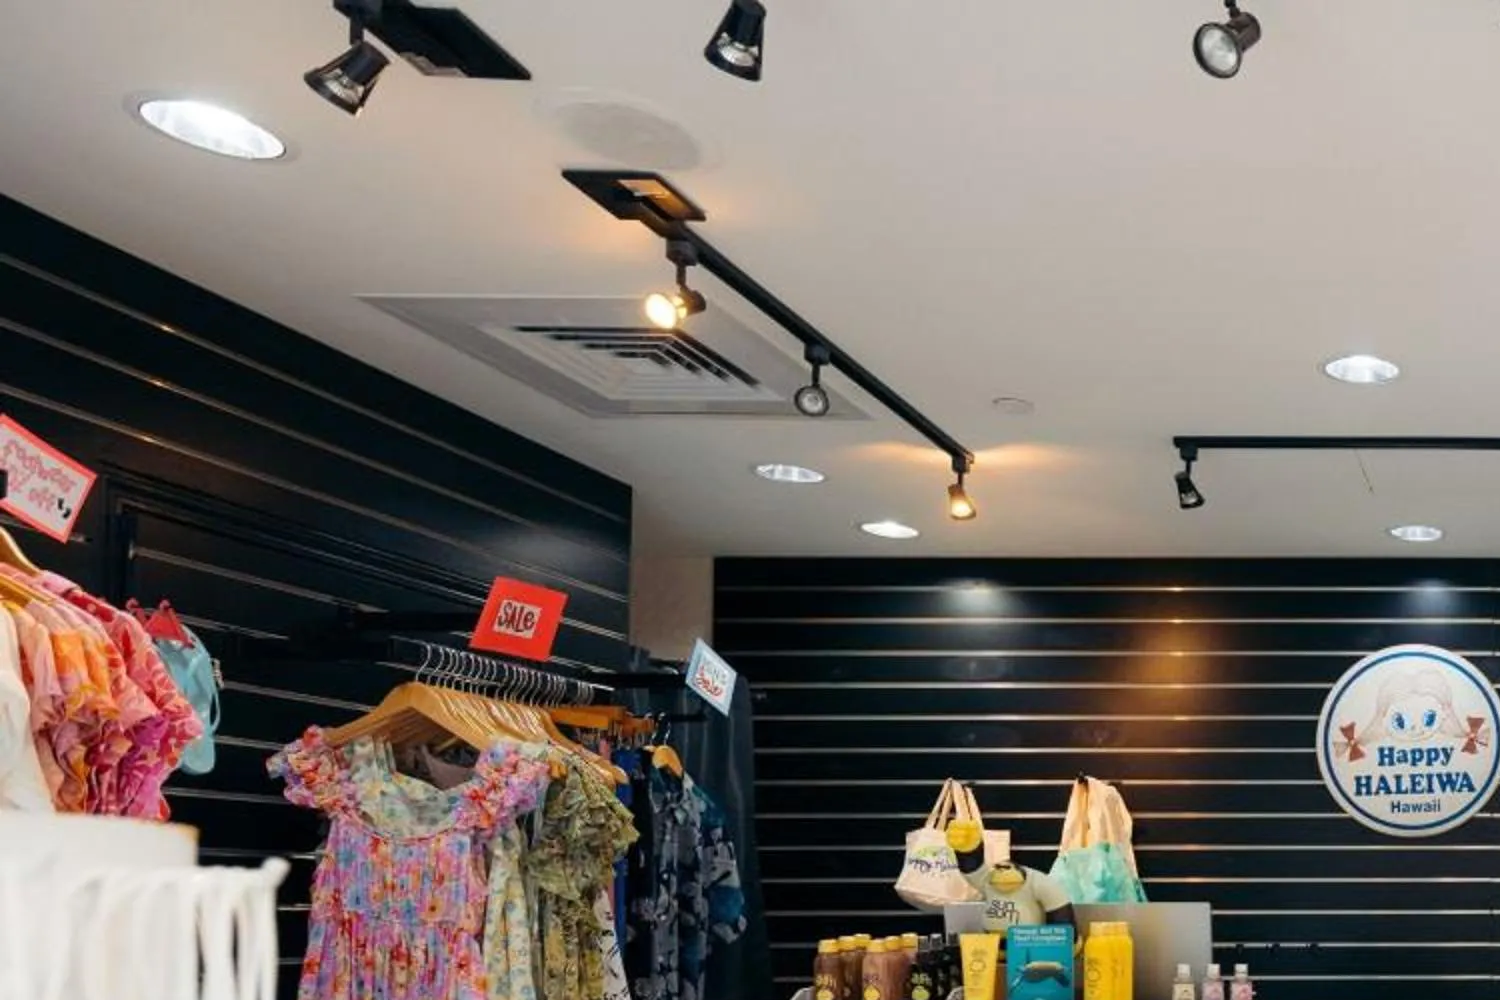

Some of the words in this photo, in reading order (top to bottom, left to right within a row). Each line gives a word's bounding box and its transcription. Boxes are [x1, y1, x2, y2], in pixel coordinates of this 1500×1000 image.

[1377, 746, 1454, 769] Happy
[1353, 771, 1477, 797] HALEIWA
[1391, 800, 1441, 814] Hawaii
